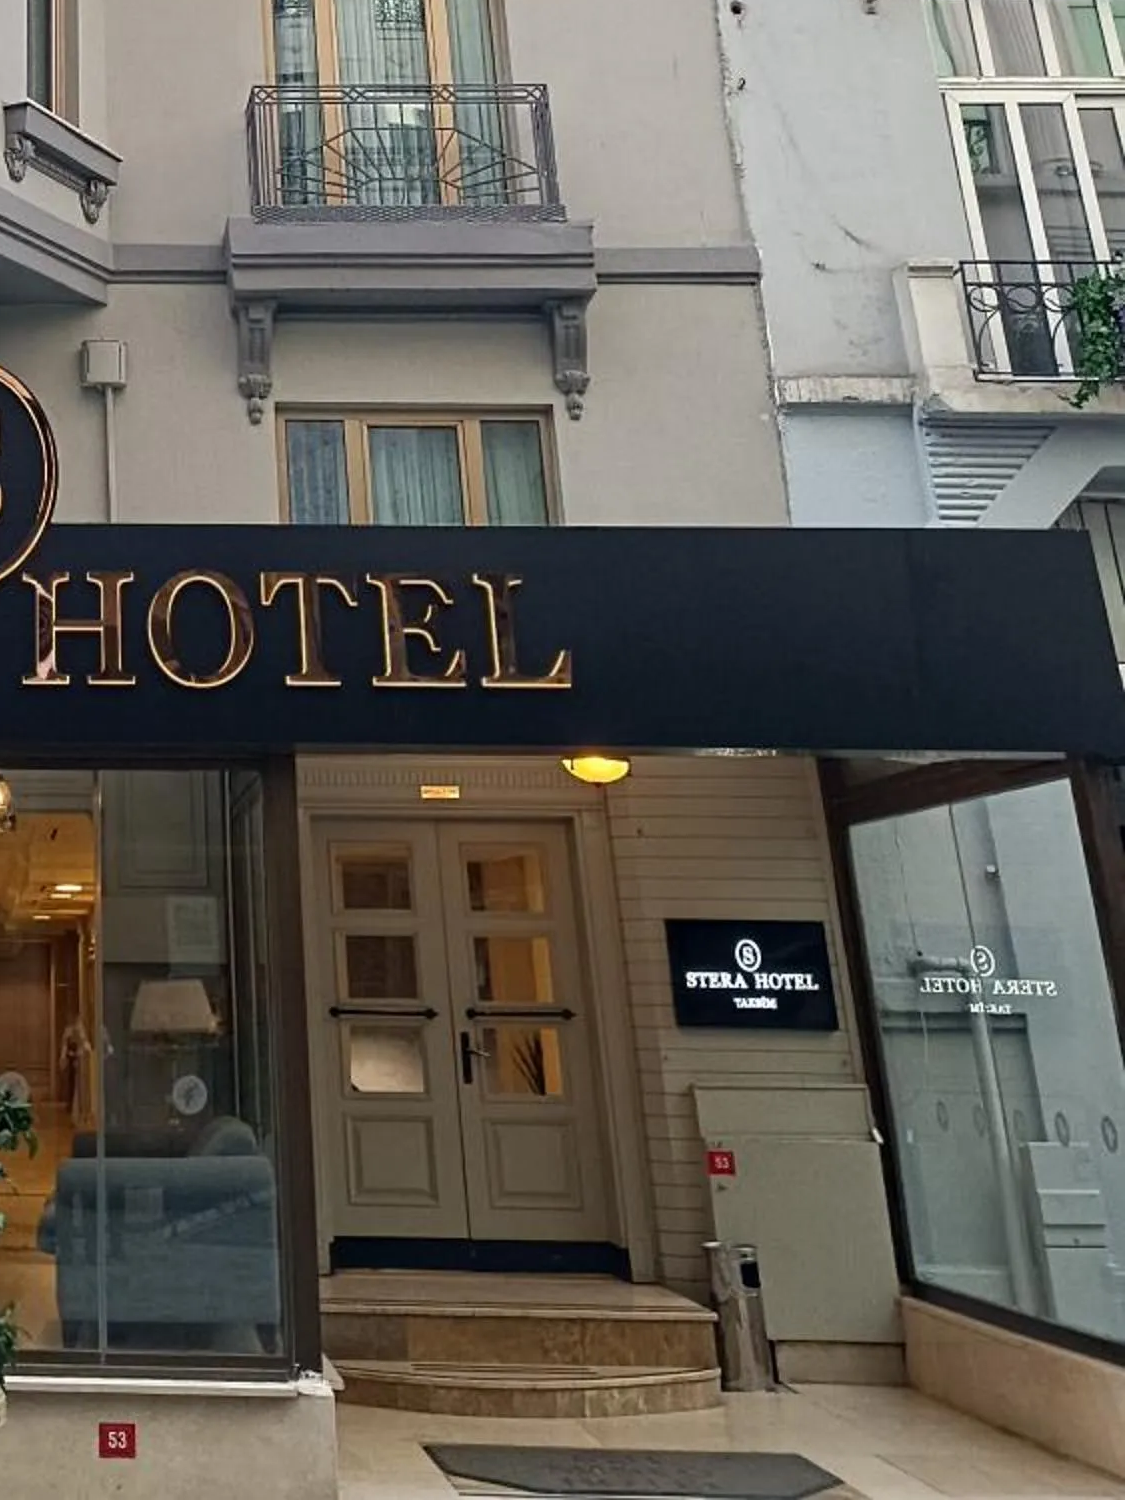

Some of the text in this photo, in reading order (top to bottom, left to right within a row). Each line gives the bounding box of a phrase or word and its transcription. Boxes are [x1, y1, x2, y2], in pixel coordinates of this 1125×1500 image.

[21, 569, 573, 690] HOTEL
[686, 972, 819, 990] STERA HOTEL
[107, 1431, 127, 1449] 53
